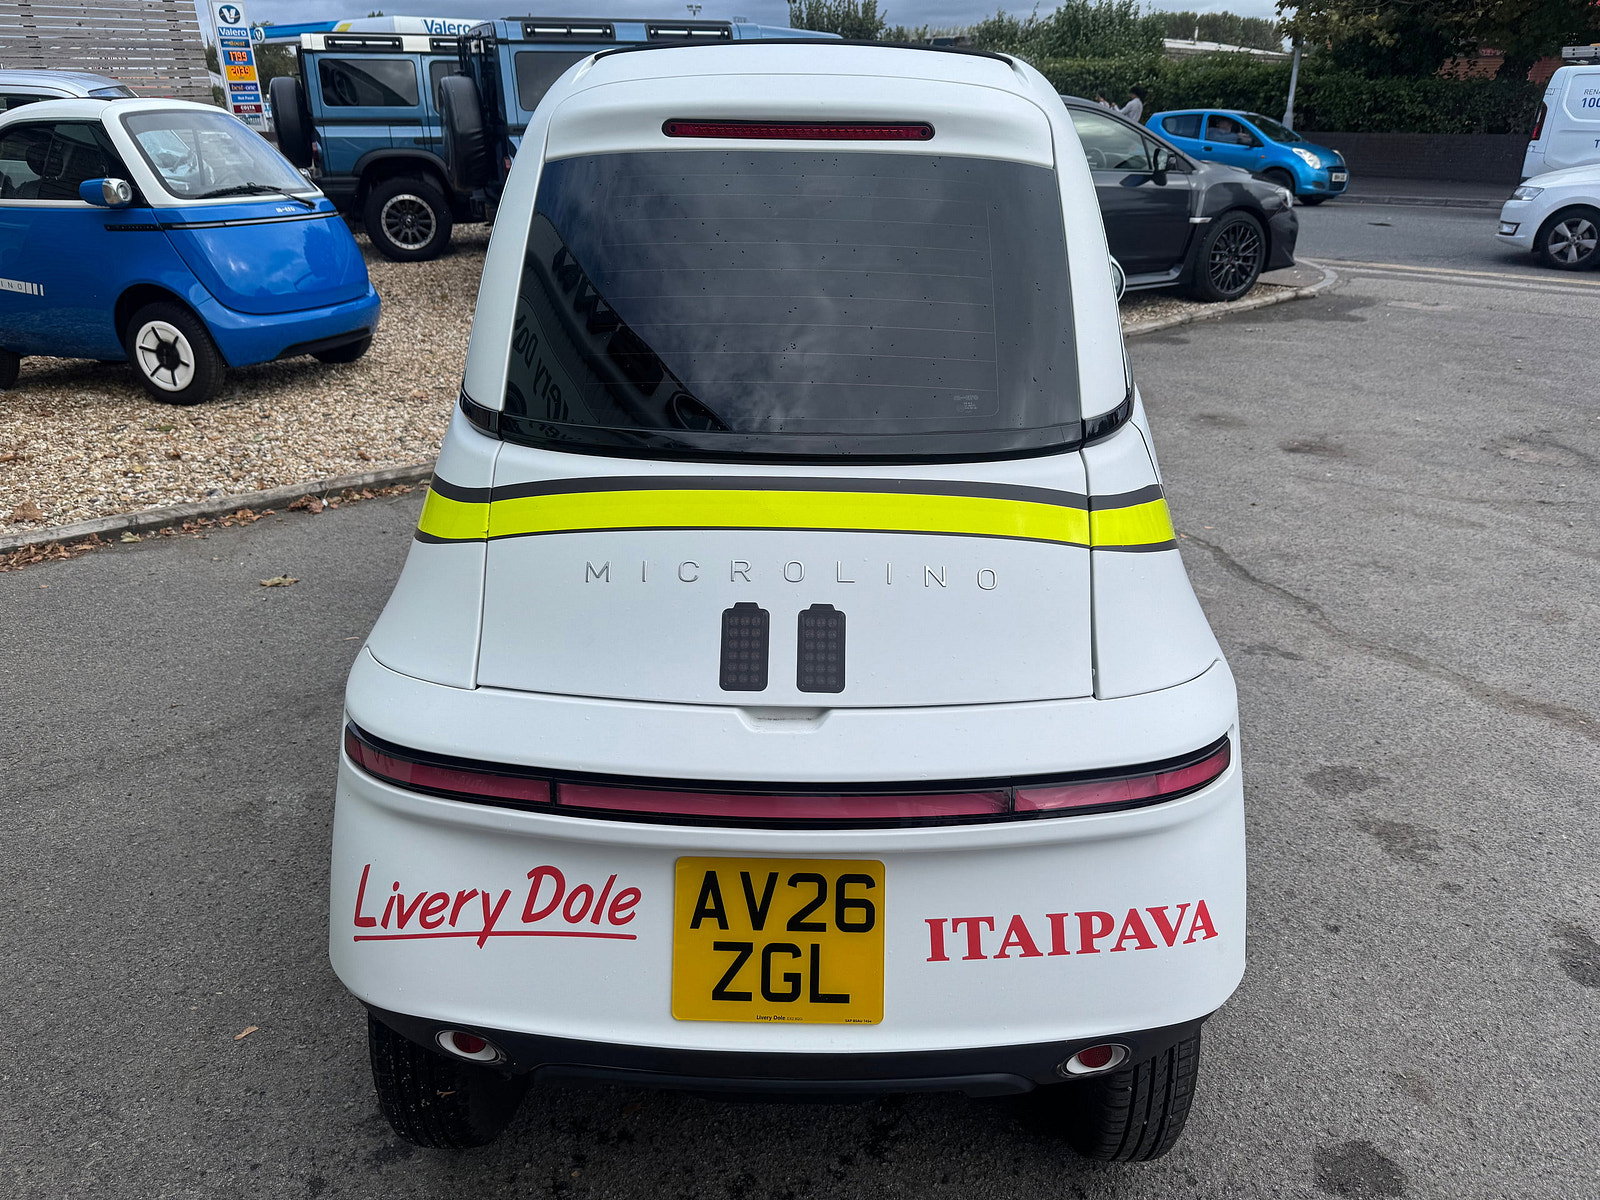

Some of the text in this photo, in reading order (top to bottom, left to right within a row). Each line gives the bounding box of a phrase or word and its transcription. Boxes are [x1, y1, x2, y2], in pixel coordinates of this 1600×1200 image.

[219, 28, 247, 36] Valero
[423, 19, 470, 35] Valero
[585, 559, 999, 591] MICROLINO
[354, 863, 643, 949] Livery Dole
[690, 870, 876, 933] AV26
[924, 899, 1219, 962] ITAIPAVA
[711, 941, 850, 1004] ZGL
